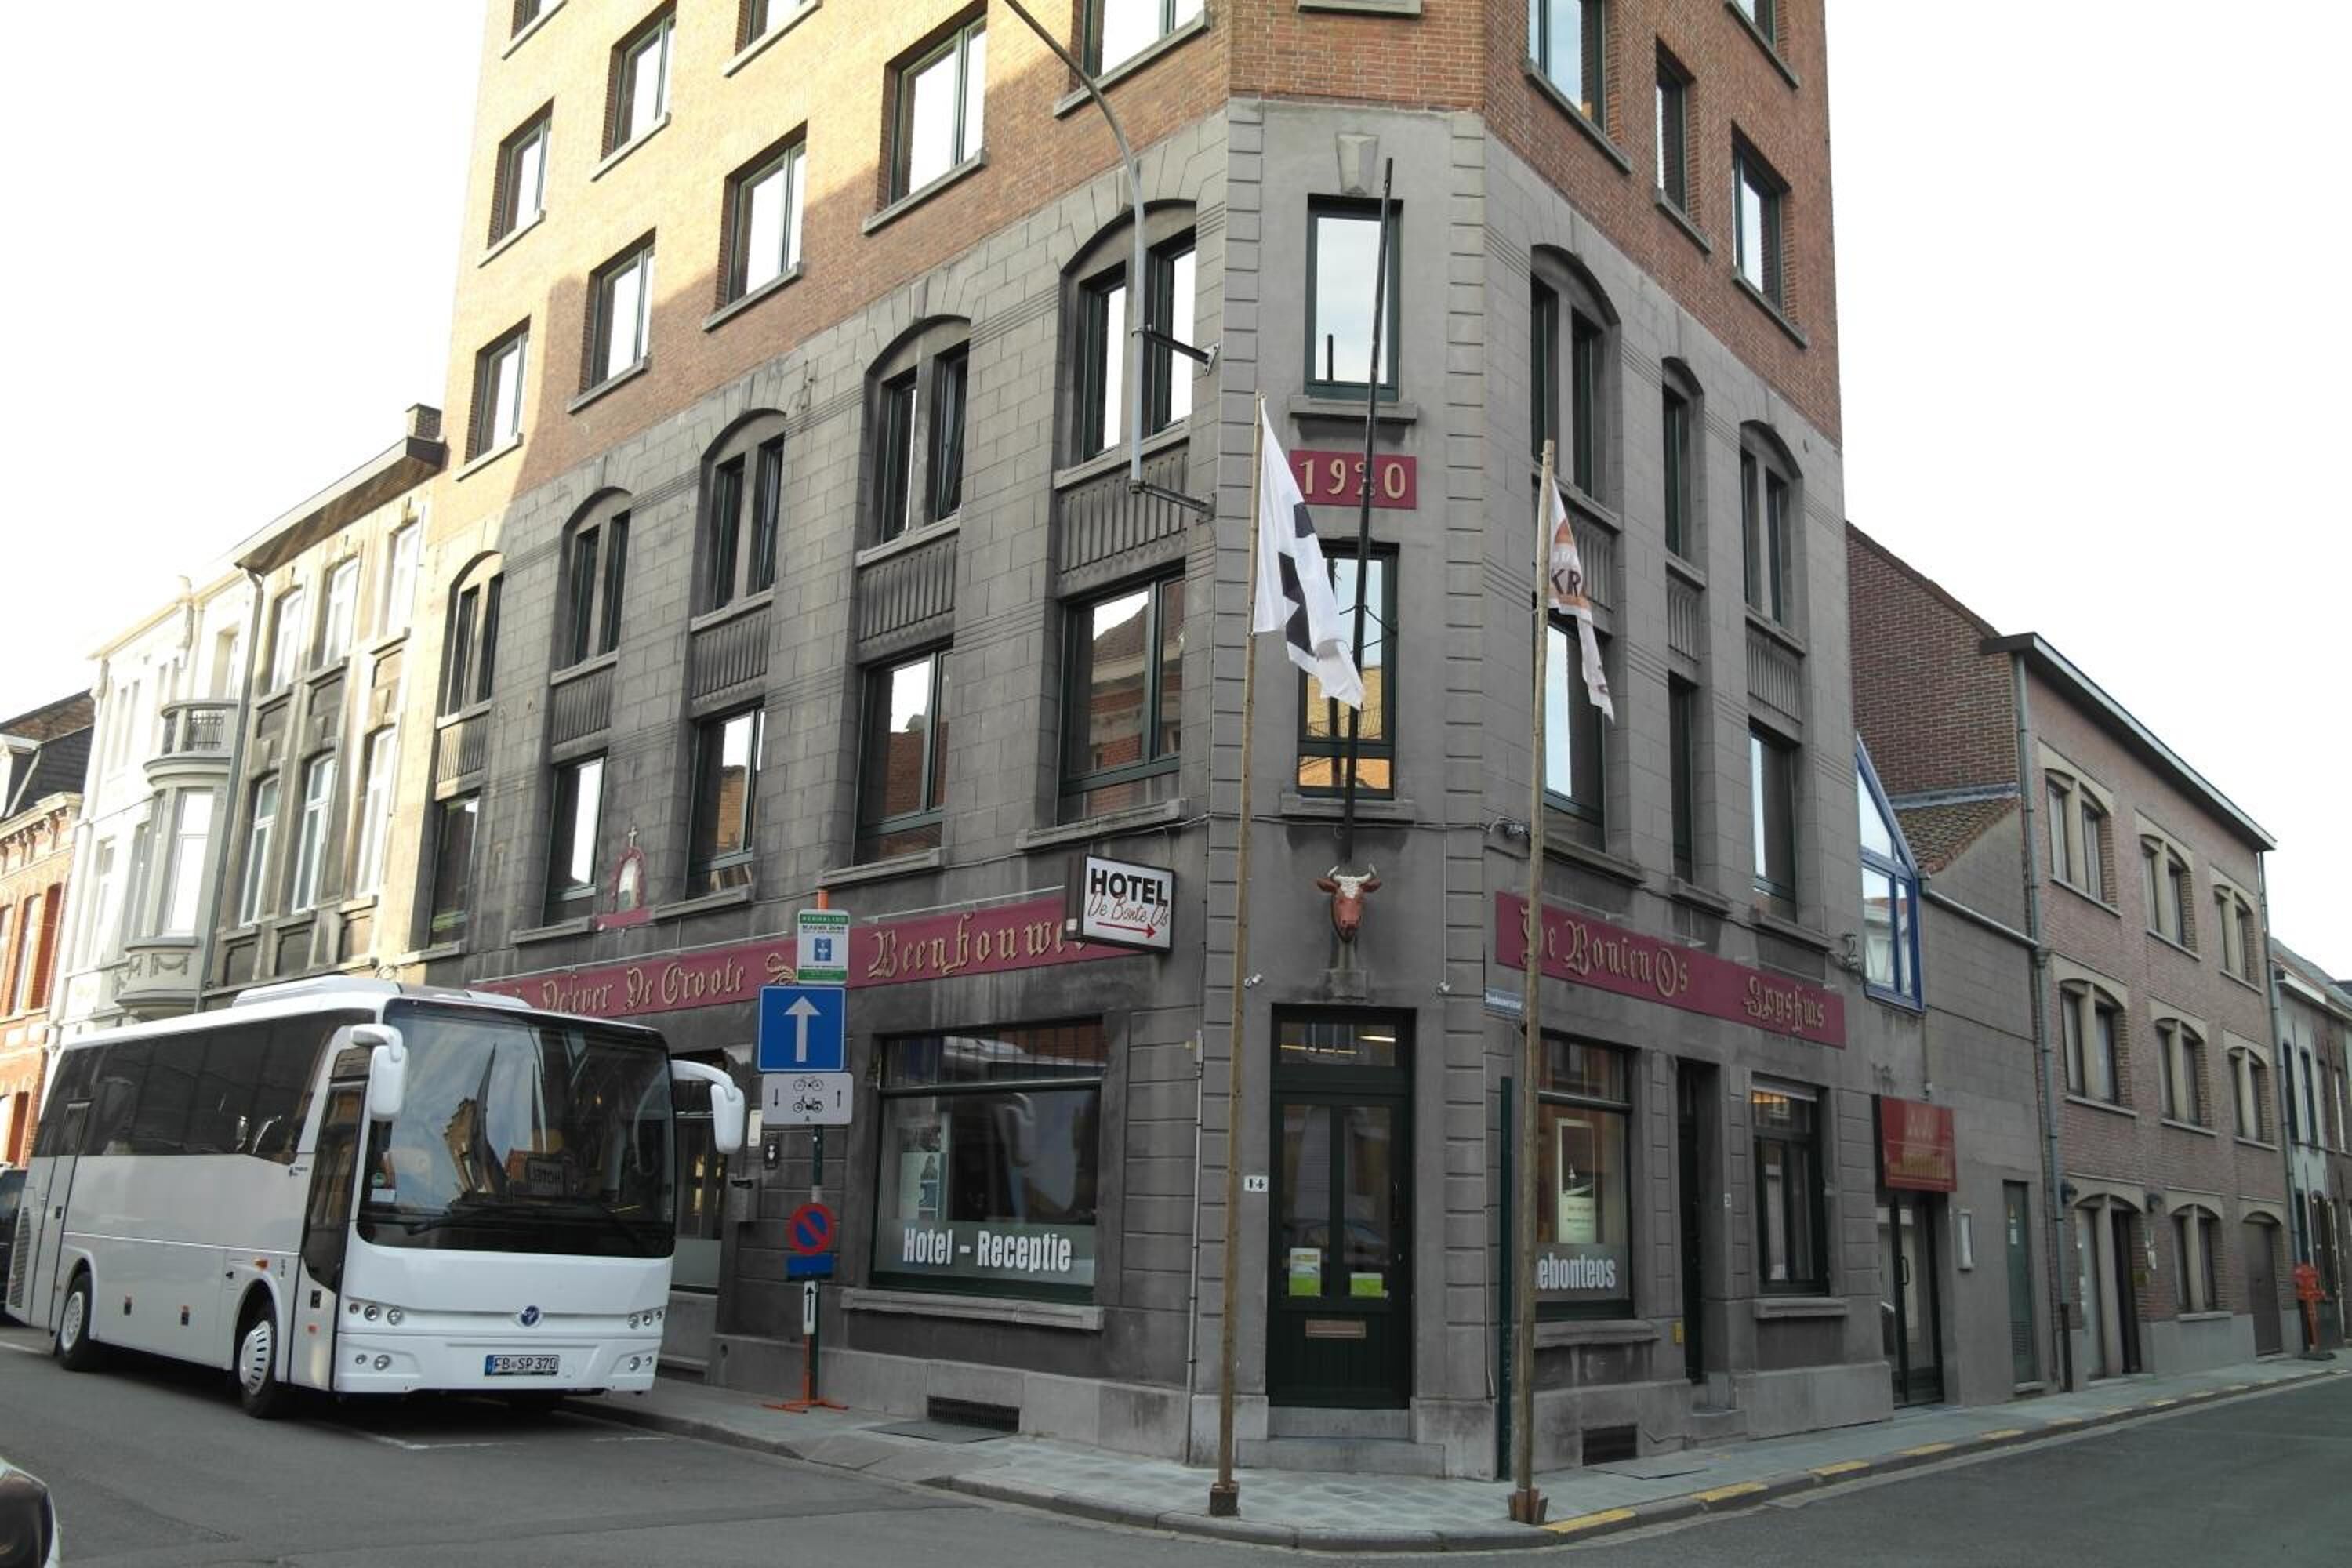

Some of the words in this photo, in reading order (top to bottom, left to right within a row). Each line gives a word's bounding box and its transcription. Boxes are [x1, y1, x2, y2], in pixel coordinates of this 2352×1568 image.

[1091, 868, 1168, 906] HOTEL
[1088, 891, 1107, 916] De
[1112, 895, 1148, 923] Bonte
[626, 966, 653, 1008] De
[868, 913, 1086, 978] Beenhouwe
[903, 1228, 953, 1265] Hotel
[978, 1230, 1072, 1272] Receptie
[1535, 1252, 1616, 1290] ebonteos
